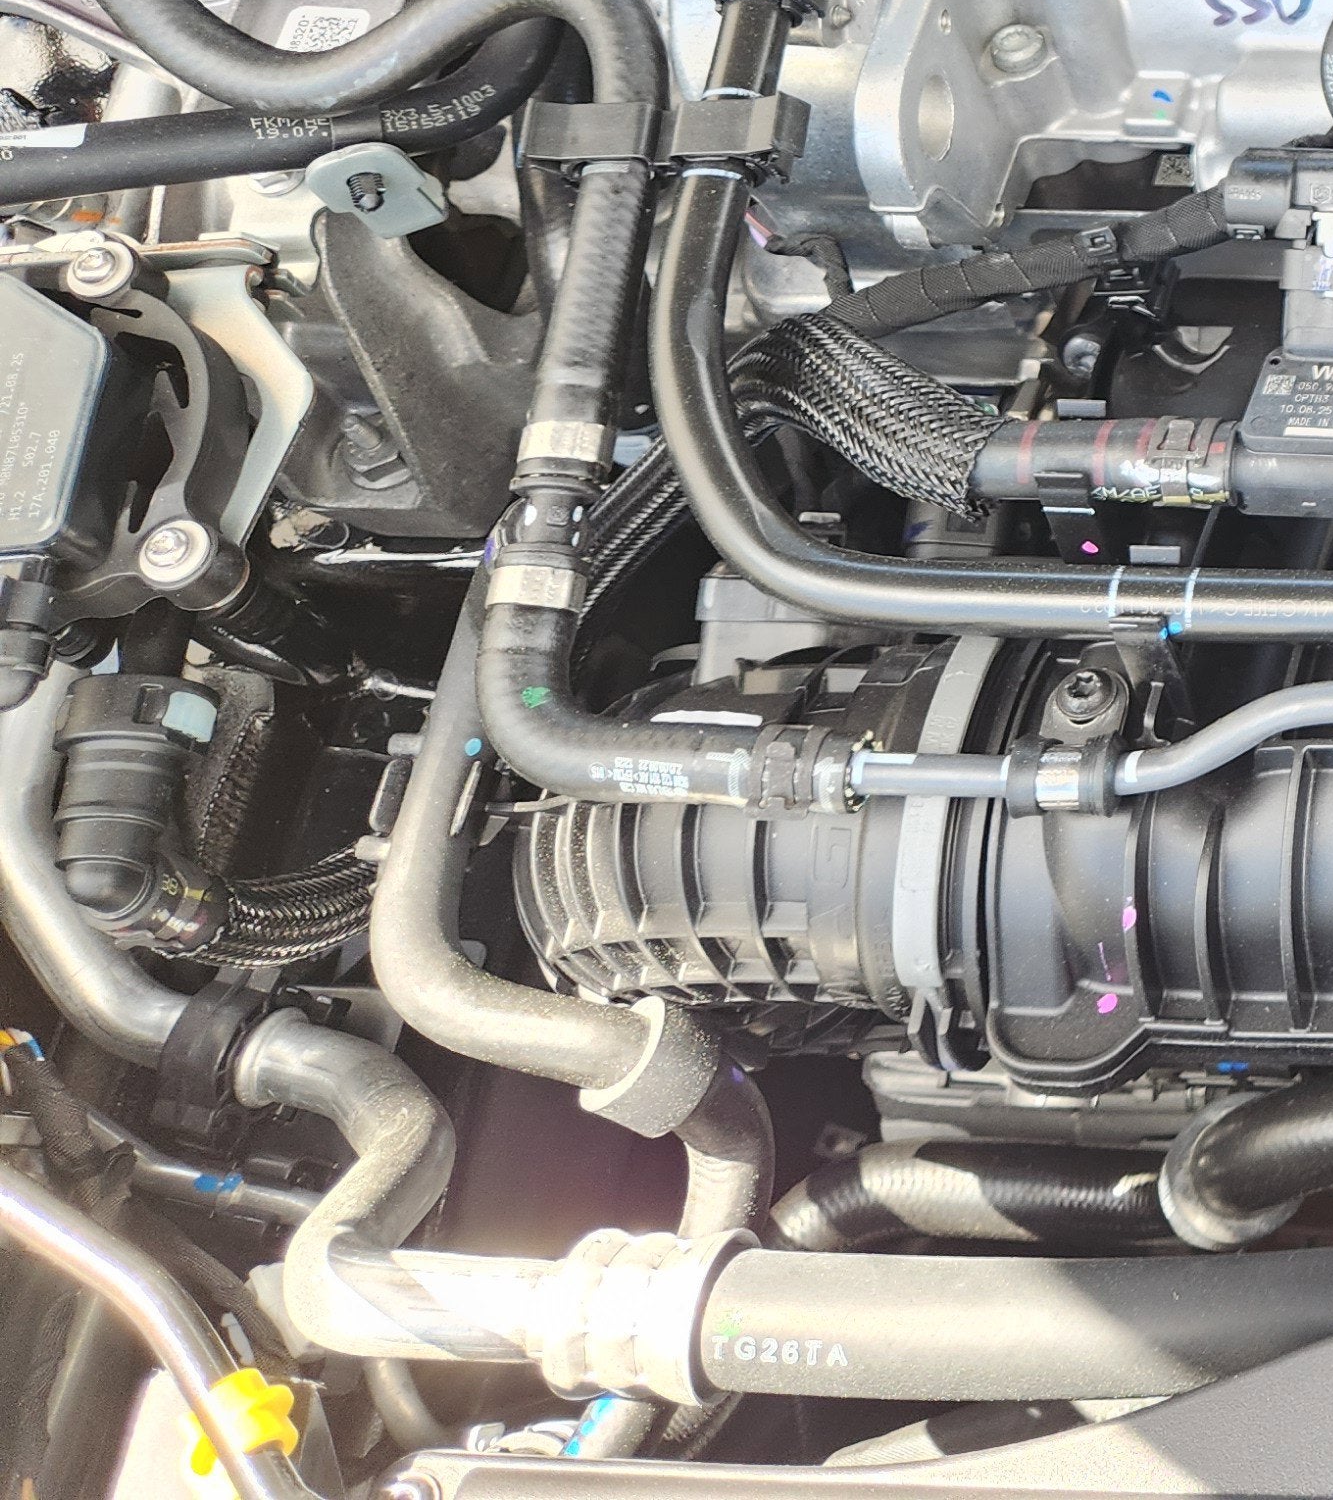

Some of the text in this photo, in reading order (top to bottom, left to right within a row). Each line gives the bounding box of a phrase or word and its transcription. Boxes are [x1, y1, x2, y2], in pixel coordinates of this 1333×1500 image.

[1288, 417, 1311, 426] MADE
[1319, 418, 1328, 427] IN
[713, 1332, 849, 1368] TG26TA
